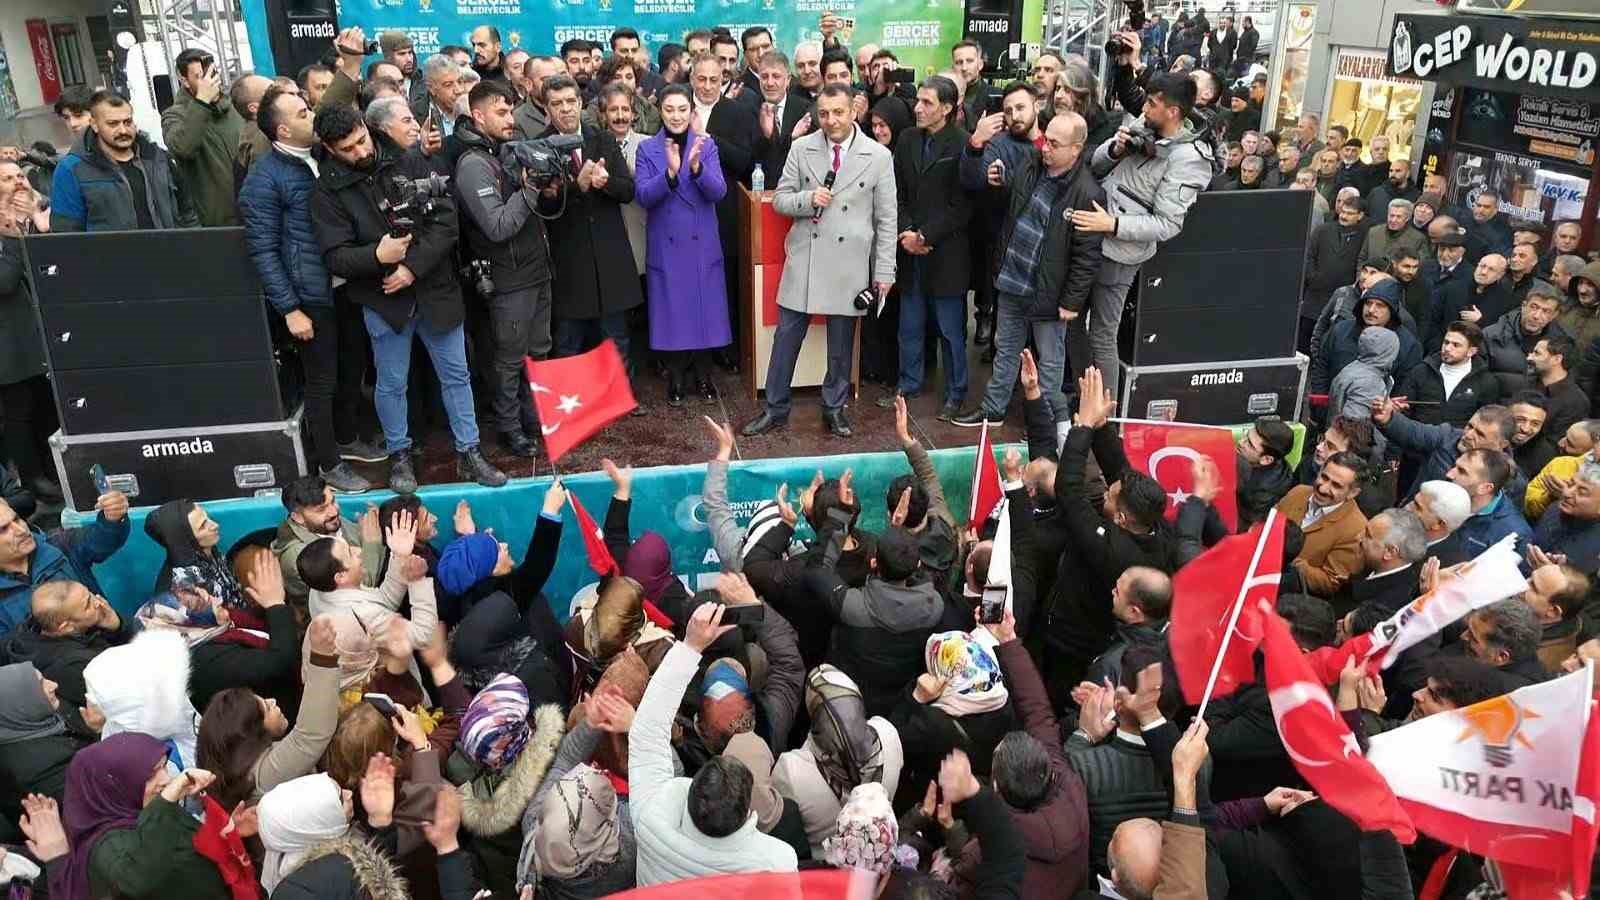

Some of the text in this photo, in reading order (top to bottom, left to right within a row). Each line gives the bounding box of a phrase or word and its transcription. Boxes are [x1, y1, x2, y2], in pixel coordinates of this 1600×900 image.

[291, 21, 335, 38] armada
[969, 18, 1008, 33] armada
[1413, 25, 1471, 77] CEP
[1475, 32, 1597, 89] WORLD
[1191, 368, 1244, 386] armada
[142, 437, 214, 457] armada
